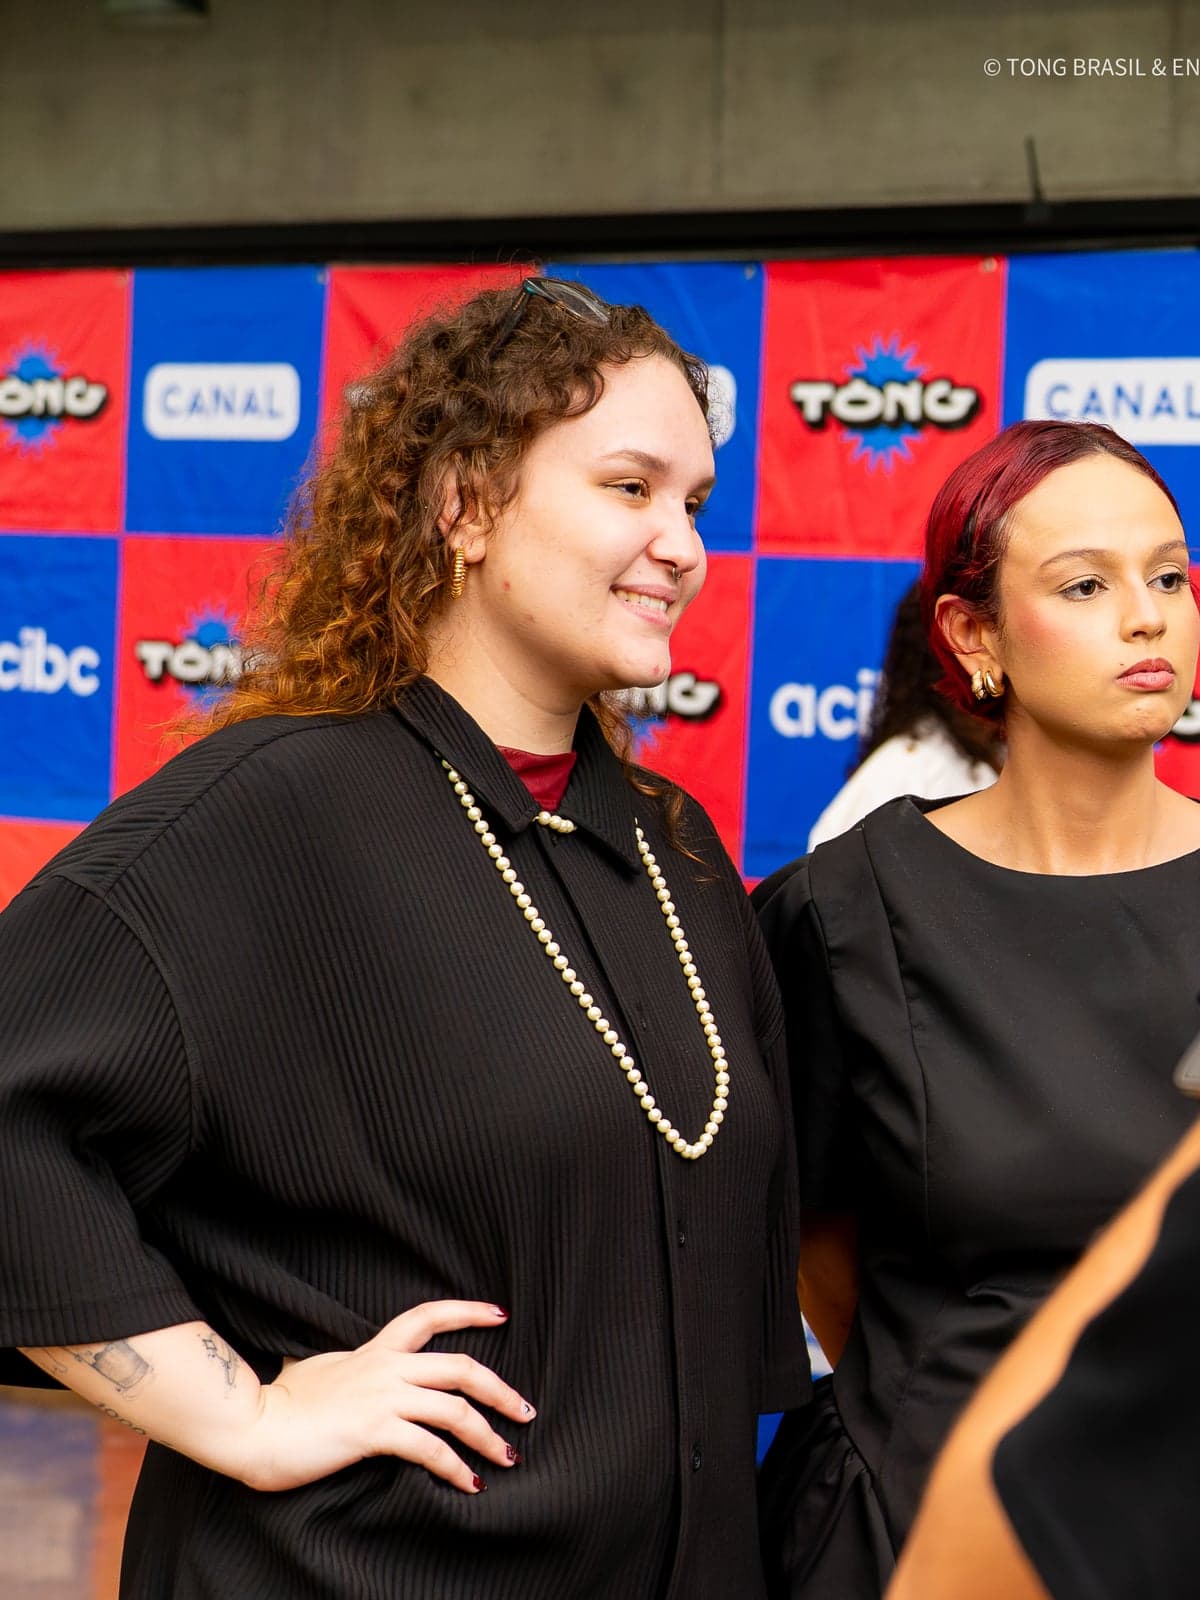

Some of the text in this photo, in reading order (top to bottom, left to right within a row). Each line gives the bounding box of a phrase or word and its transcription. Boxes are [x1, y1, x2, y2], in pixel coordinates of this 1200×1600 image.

[0, 375, 109, 418] ONG
[159, 382, 284, 419] CANAL
[0, 626, 100, 697] cibc
[768, 667, 878, 741] aci
